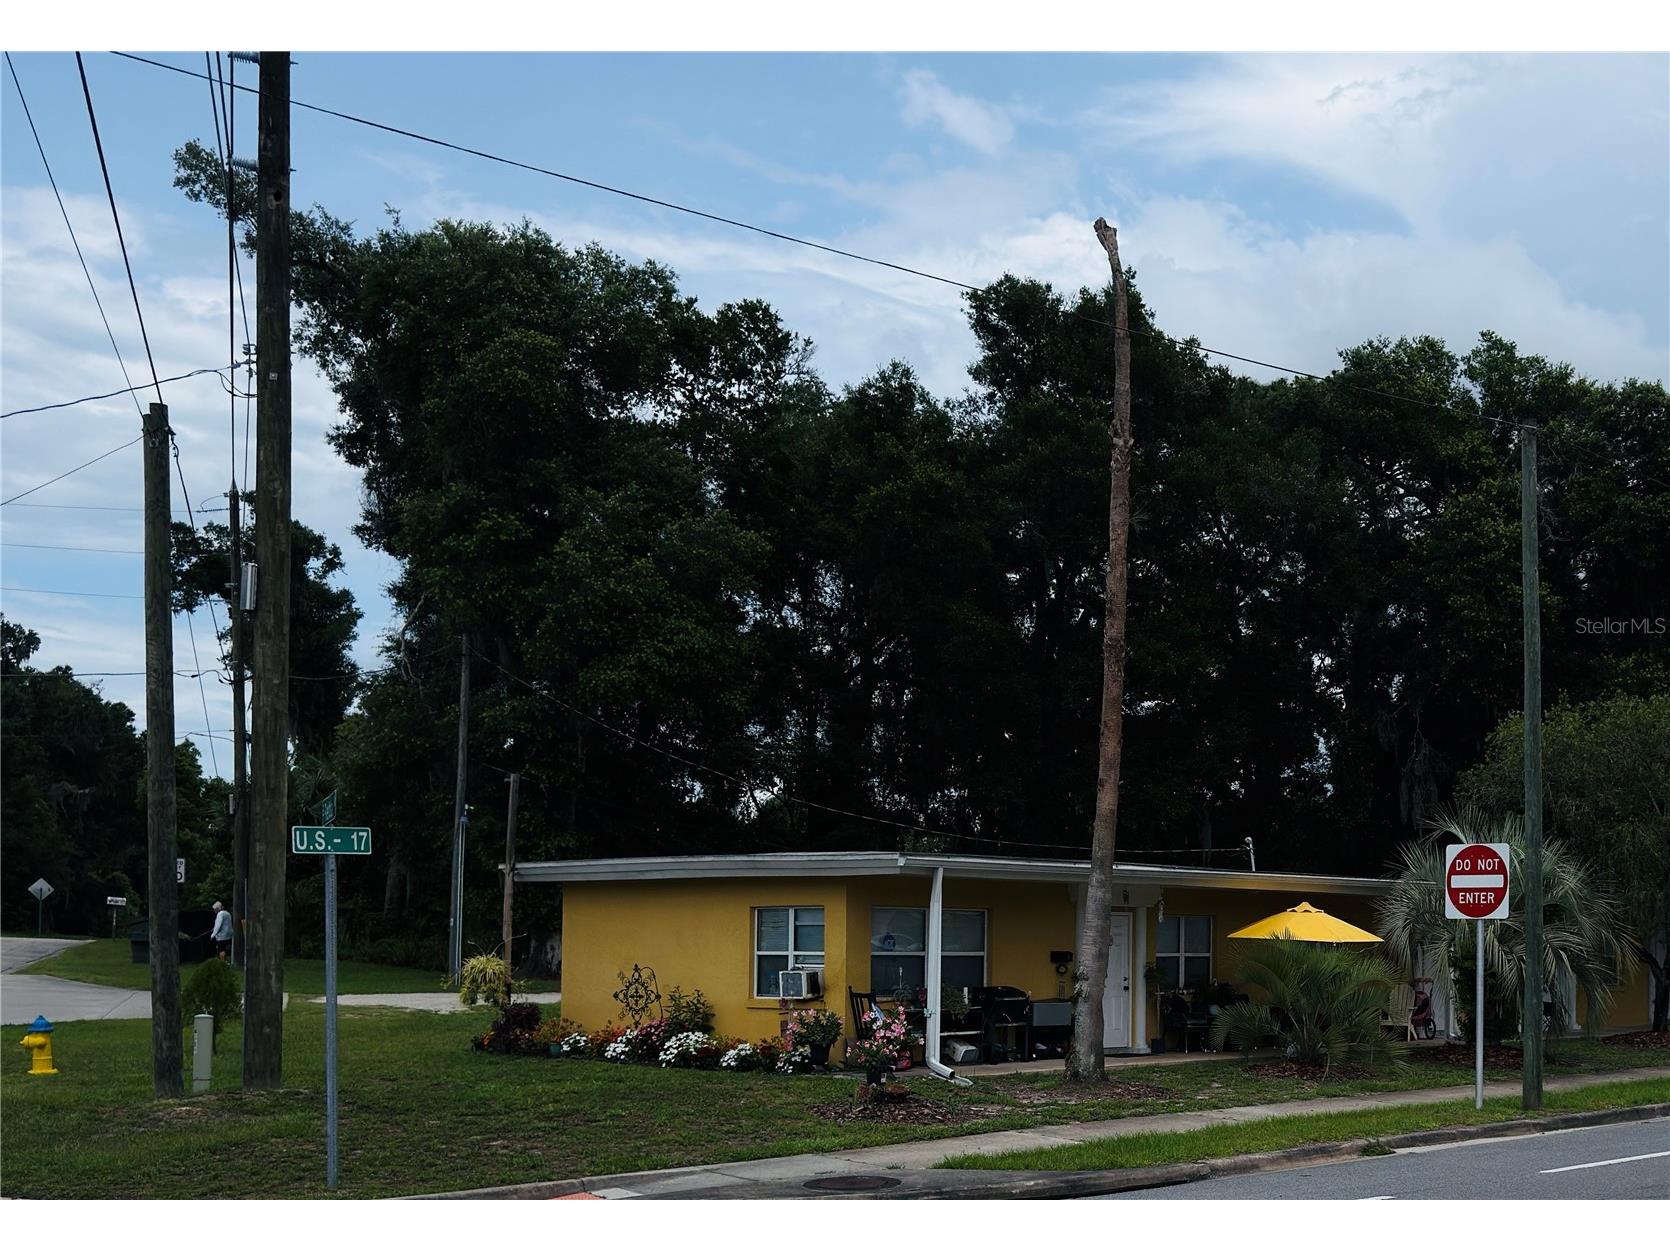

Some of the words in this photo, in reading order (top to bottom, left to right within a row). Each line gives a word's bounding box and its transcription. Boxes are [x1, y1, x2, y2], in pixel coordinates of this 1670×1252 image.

[351, 831, 368, 851] 17
[1455, 859, 1471, 871] DO
[1477, 858, 1500, 871] NOT
[1458, 892, 1495, 904] ENTER
